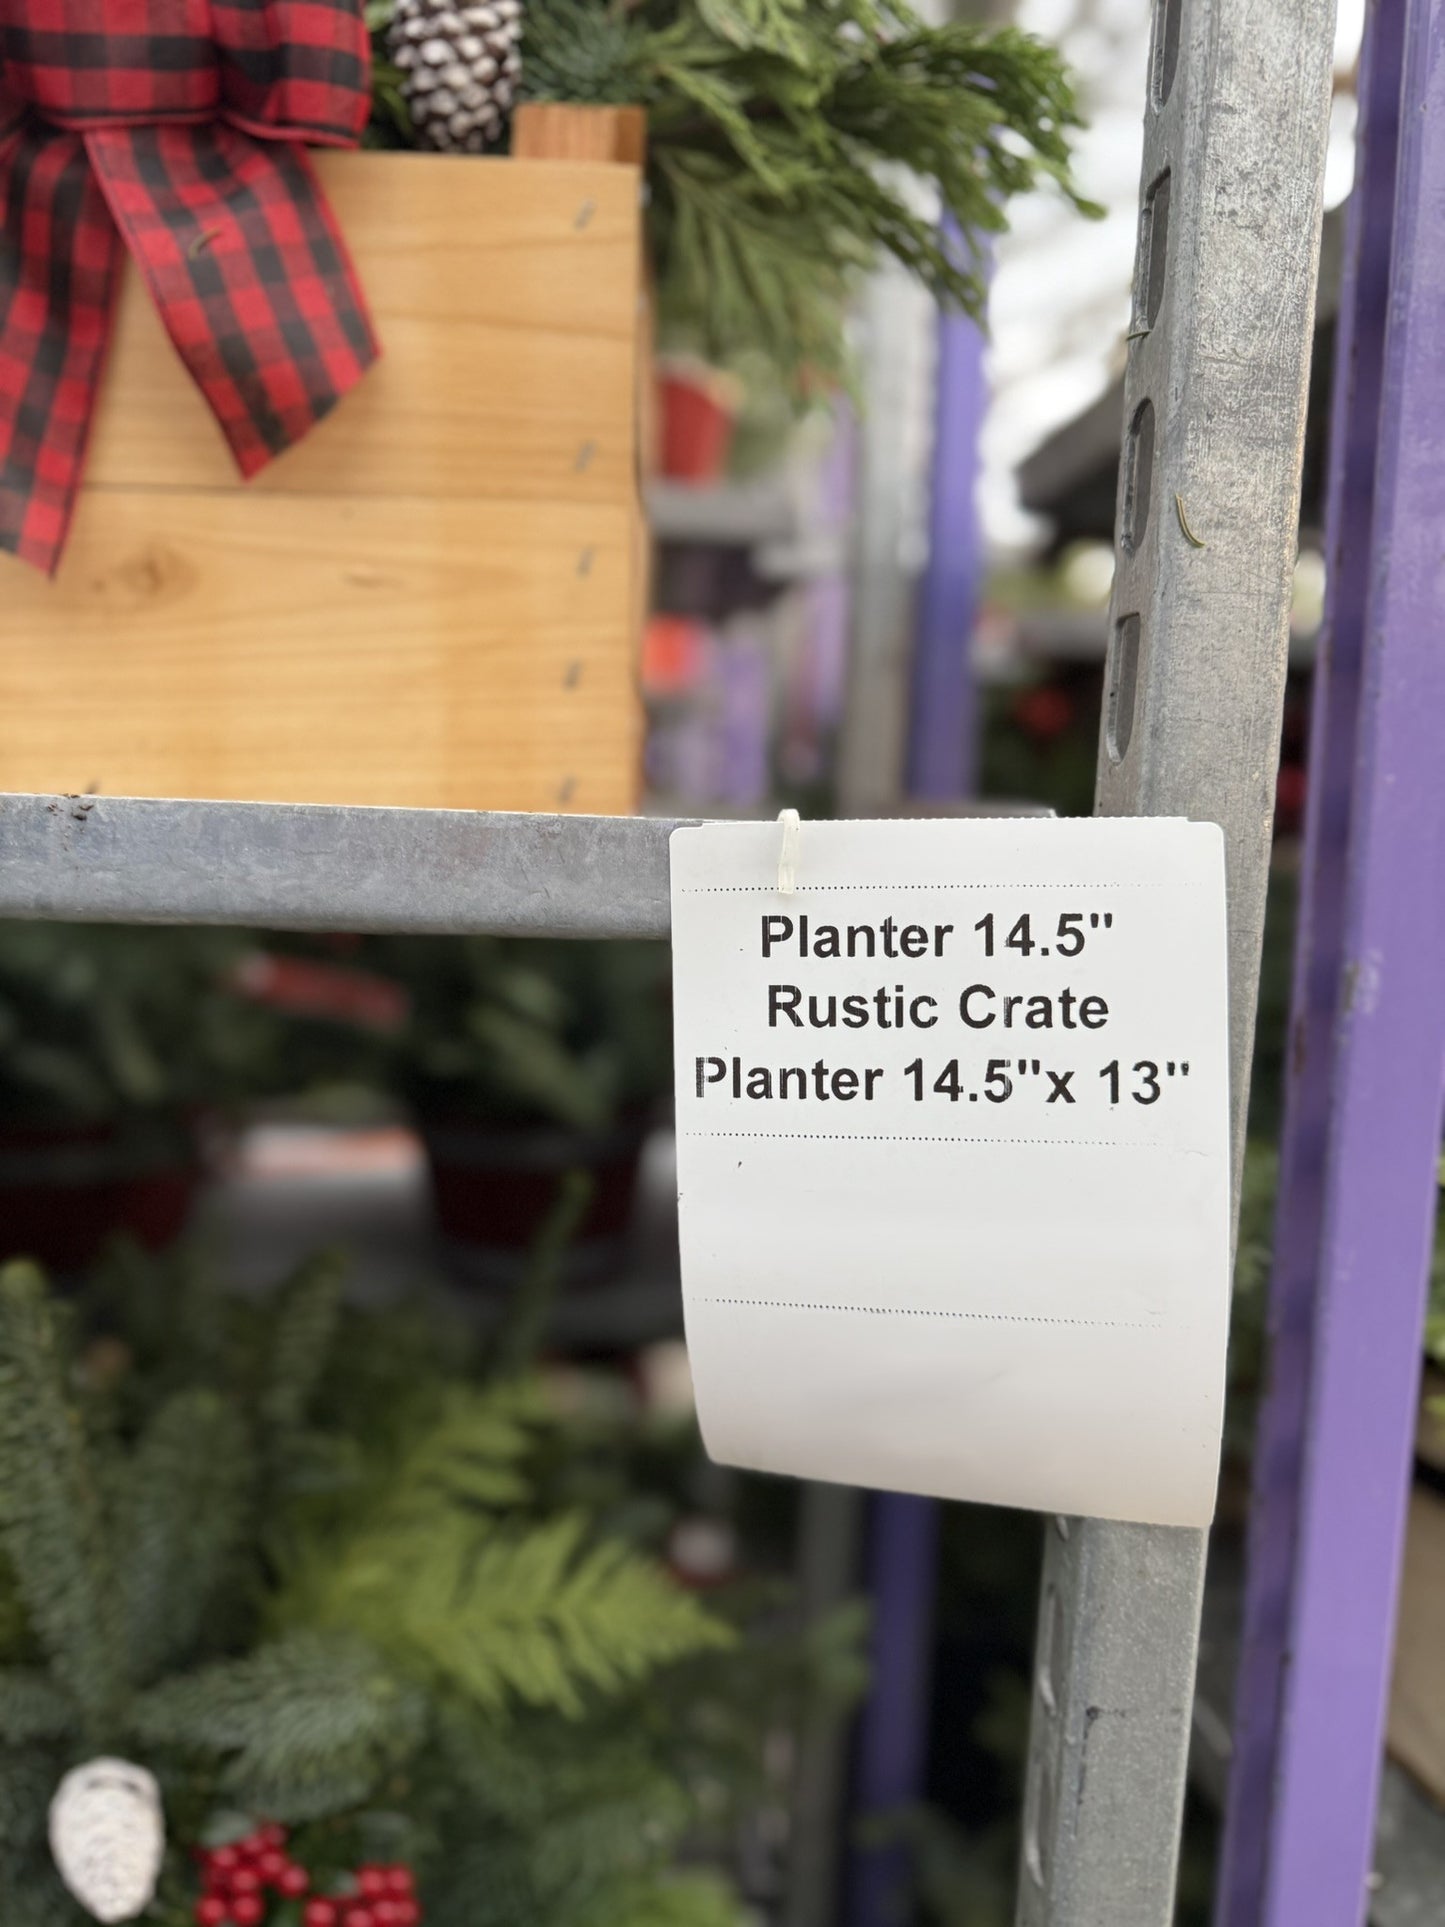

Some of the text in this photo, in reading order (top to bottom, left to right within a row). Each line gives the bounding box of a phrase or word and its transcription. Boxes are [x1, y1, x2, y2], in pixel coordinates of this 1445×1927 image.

[761, 912, 1113, 959] Planter 14.5"
[768, 983, 1109, 1030] Rustic Crate
[695, 1056, 884, 1102] Planter
[1099, 1059, 1190, 1106] 13"
